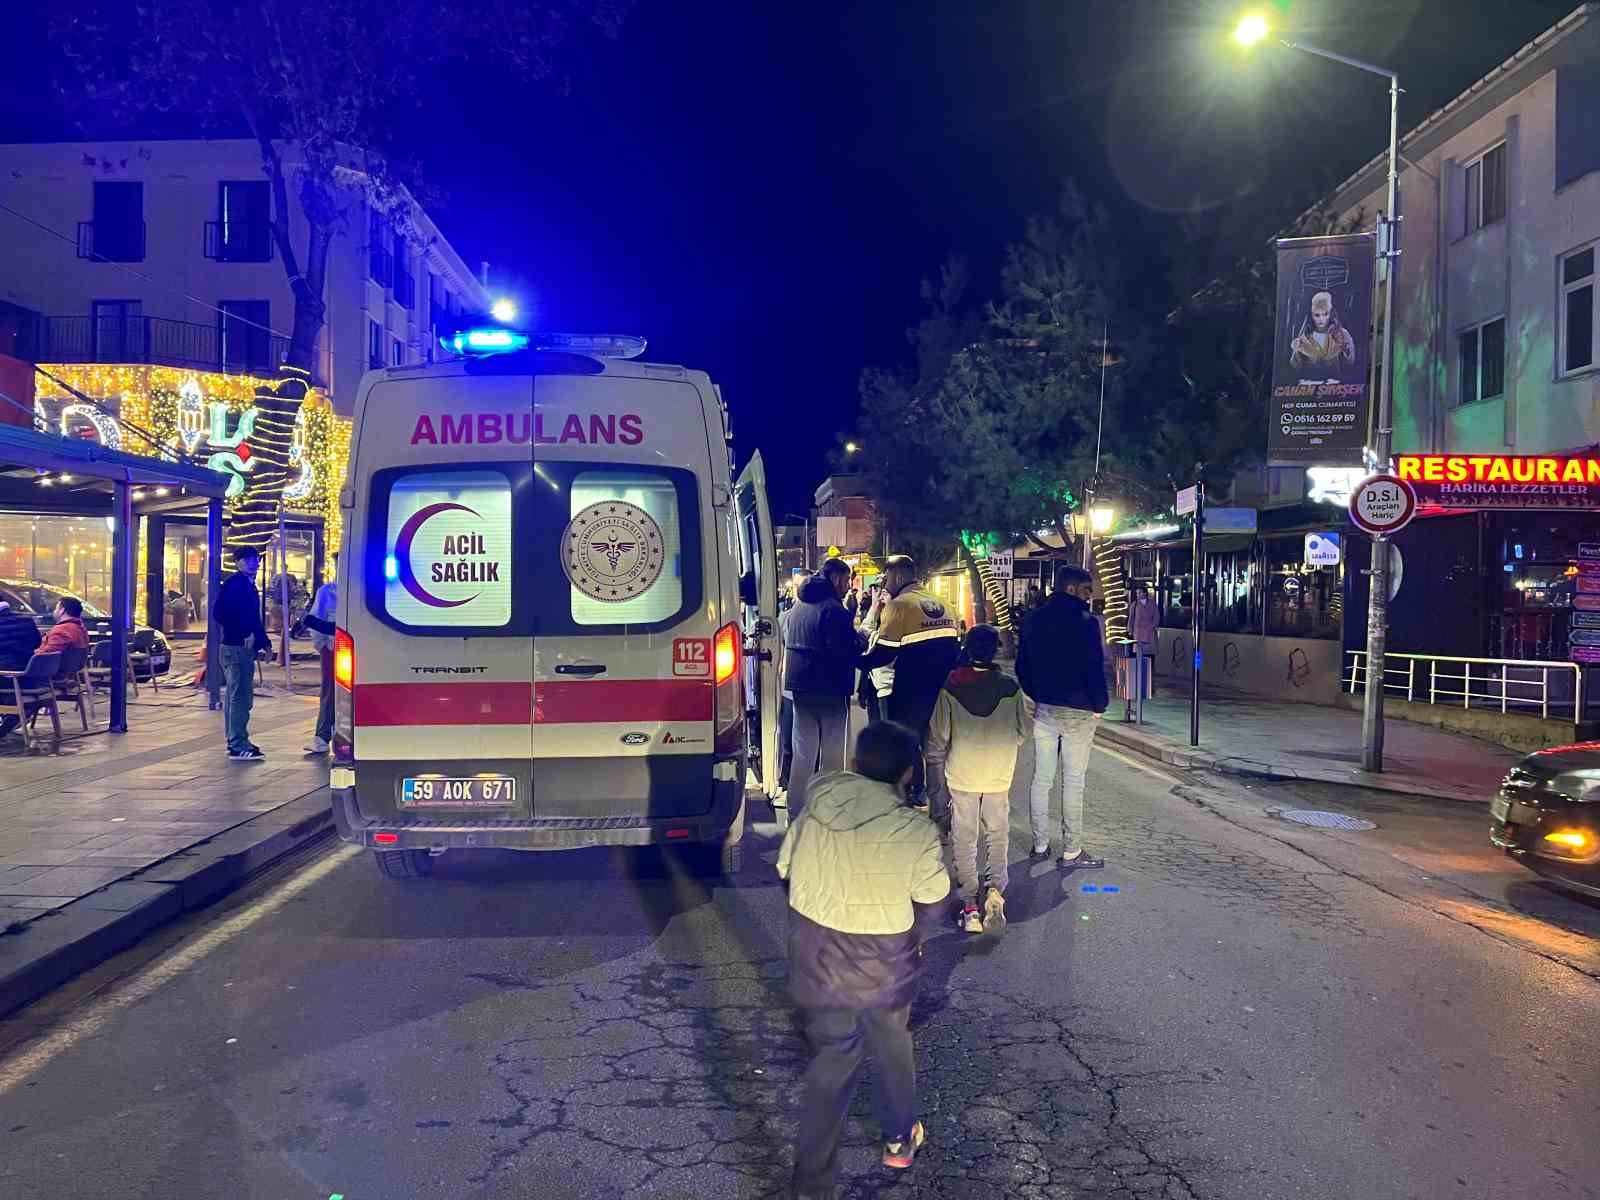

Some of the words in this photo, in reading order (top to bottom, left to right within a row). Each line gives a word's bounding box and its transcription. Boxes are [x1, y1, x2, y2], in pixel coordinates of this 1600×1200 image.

[410, 413, 644, 445] AMBULANS
[1440, 482, 1497, 494] HARİKA
[1501, 484, 1588, 495] LEZZETLER
[443, 532, 486, 555] ACİL
[431, 558, 500, 582] SAĞLIK
[678, 642, 705, 660] 112
[410, 666, 488, 674] TRANSIT
[624, 733, 646, 745] Ford
[413, 781, 433, 799] 59
[443, 781, 472, 799] AOK
[482, 781, 511, 799] 671
